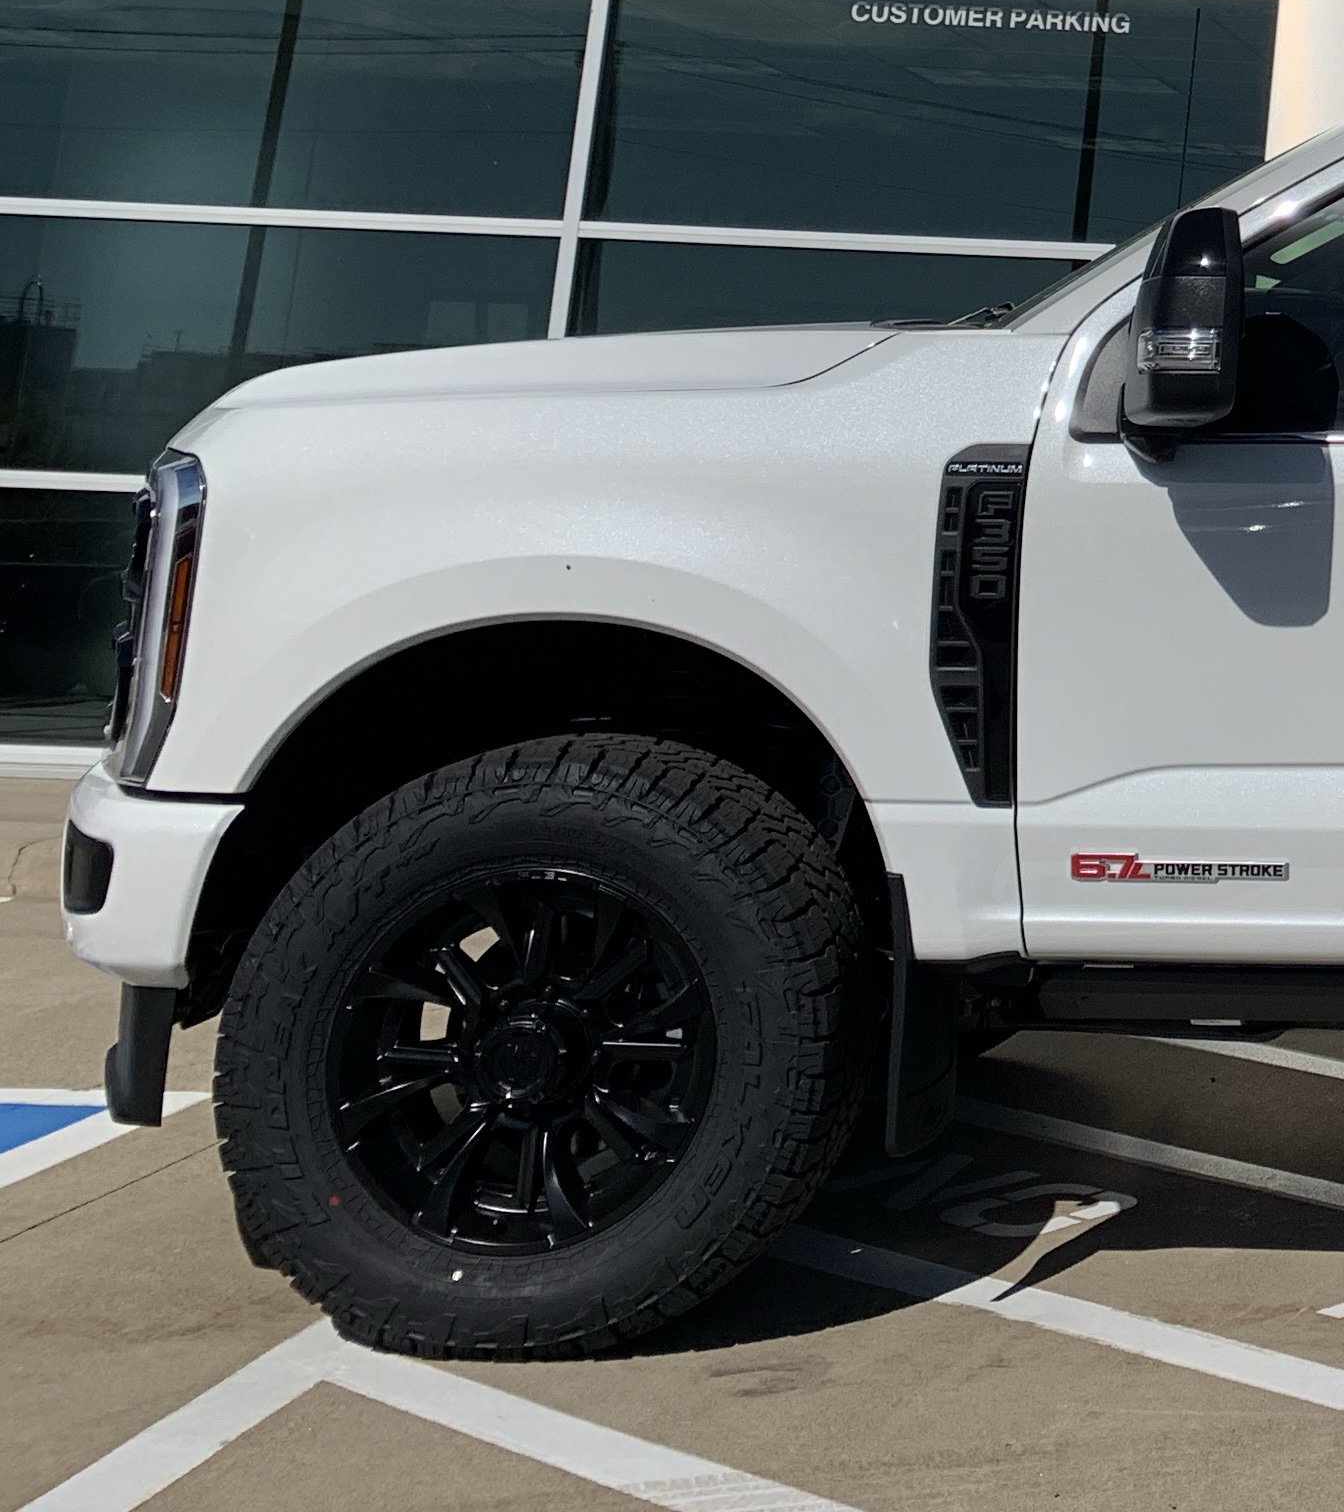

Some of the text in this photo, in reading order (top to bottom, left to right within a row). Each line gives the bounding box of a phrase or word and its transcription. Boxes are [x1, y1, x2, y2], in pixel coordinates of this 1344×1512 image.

[850, 1, 1131, 34] CUSTOMER PARKING
[948, 462, 1023, 475] PLATINUM
[968, 489, 1014, 600] F350
[1071, 853, 1284, 879] 6.7L POWER STROKE
